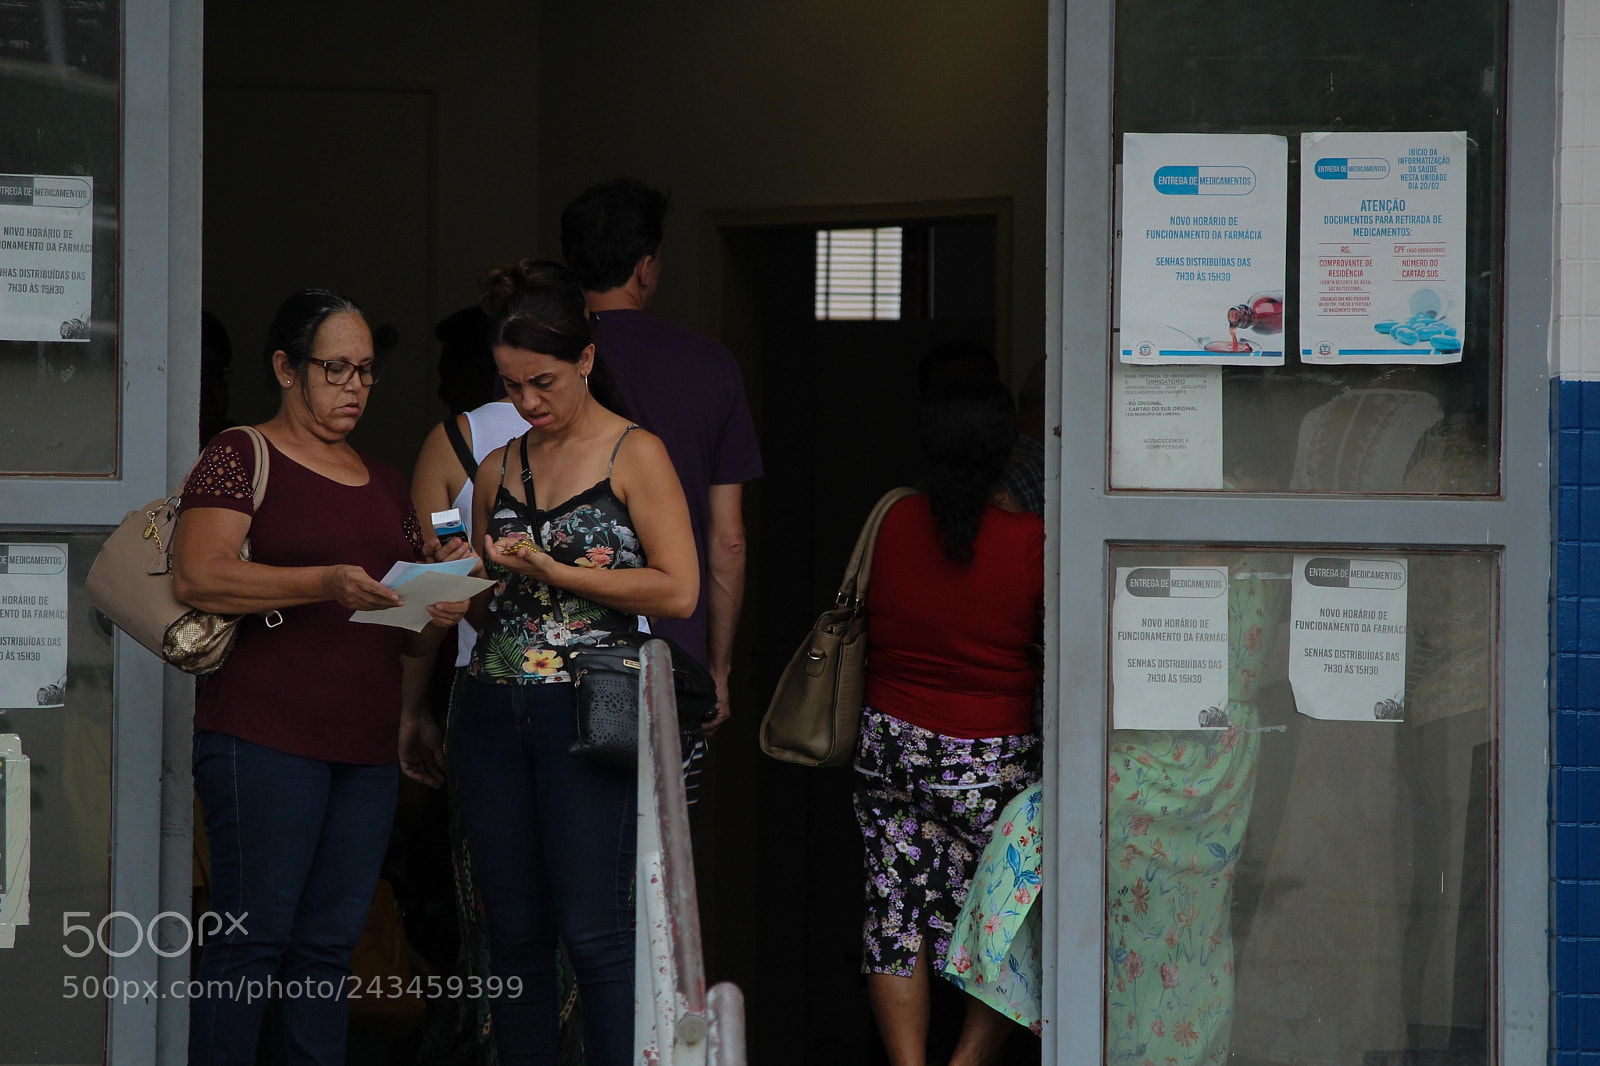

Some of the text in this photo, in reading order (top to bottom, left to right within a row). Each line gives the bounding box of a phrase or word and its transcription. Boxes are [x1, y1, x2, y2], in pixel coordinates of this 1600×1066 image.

[1408, 147, 1438, 156] INÍCIO DA
[1398, 156, 1450, 166] INFORMATIZAÇÃO
[1418, 165, 1437, 173] SAÚDE
[1159, 177, 1251, 186] ENTREGA DE MEDICAMENTOS
[1400, 174, 1448, 182] NESTA UNIDADE
[1408, 182, 1440, 190] DIA 20/02
[0, 186, 87, 198] TREGA DE MEDICAMENTOS
[1360, 198, 1406, 214] ATENÇÃO
[1170, 215, 1238, 226] NOVO HORÁRIO DE
[1324, 215, 1442, 224] DOCUMENTOS PARA RETIRADA DE
[4, 227, 73, 239] NOVO HORÁRIO DE
[1146, 229, 1262, 240] FUNCIONAMENTO DA FARMÁCIA
[1353, 228, 1412, 237] MEDICAMENTOS:
[46, 242, 57, 252] DA
[1341, 246, 1351, 254] RG,
[1156, 256, 1251, 267] SENHAS DISTRIBUÍDAS DAS
[1319, 259, 1373, 267] COMPROVANTE DE
[1402, 258, 1439, 267] NÚMERO DO
[19, 268, 70, 280] DISTRIBUÍDAS
[72, 271, 86, 281] DAS
[1176, 271, 1231, 282] 7H30 ÀS 15H30
[1328, 269, 1364, 278] RESIDÊNCIA
[1402, 269, 1439, 278] CARTÃO SUS
[8, 282, 64, 295] 7H30 ÀS 15H30
[9, 555, 62, 565] MEDICAMENTOS
[1309, 568, 1402, 580] ENTREGA DE MEDICAMENTOS
[1130, 579, 1222, 588] ENTREGA DE MEDICAMENTOS
[2, 594, 49, 606] HORÁRIO DE
[22, 610, 32, 619] DA
[1320, 608, 1388, 620] NOVO HORÁRIO DE
[1142, 617, 1209, 628] NOVO HORÁRIO DE
[1296, 621, 1359, 632] FUNCIONAMENTO
[1362, 624, 1371, 633] DA
[0, 635, 62, 647] ISTRIBUÍDAS DAS
[1118, 632, 1181, 642] FUNCIONAMENTO
[1183, 632, 1193, 642] DA
[6, 651, 15, 661] ÀS
[17, 652, 40, 661] 15H30
[1304, 648, 1400, 662] SENHAS DISTRIBUÍDAS DAS
[1128, 658, 1222, 669] SENHAS DISTRIBUÍDAS DAS
[1324, 663, 1379, 675] 7H30 ÀS 15H30
[1148, 672, 1202, 684] 7H30 ÀS 15H30
